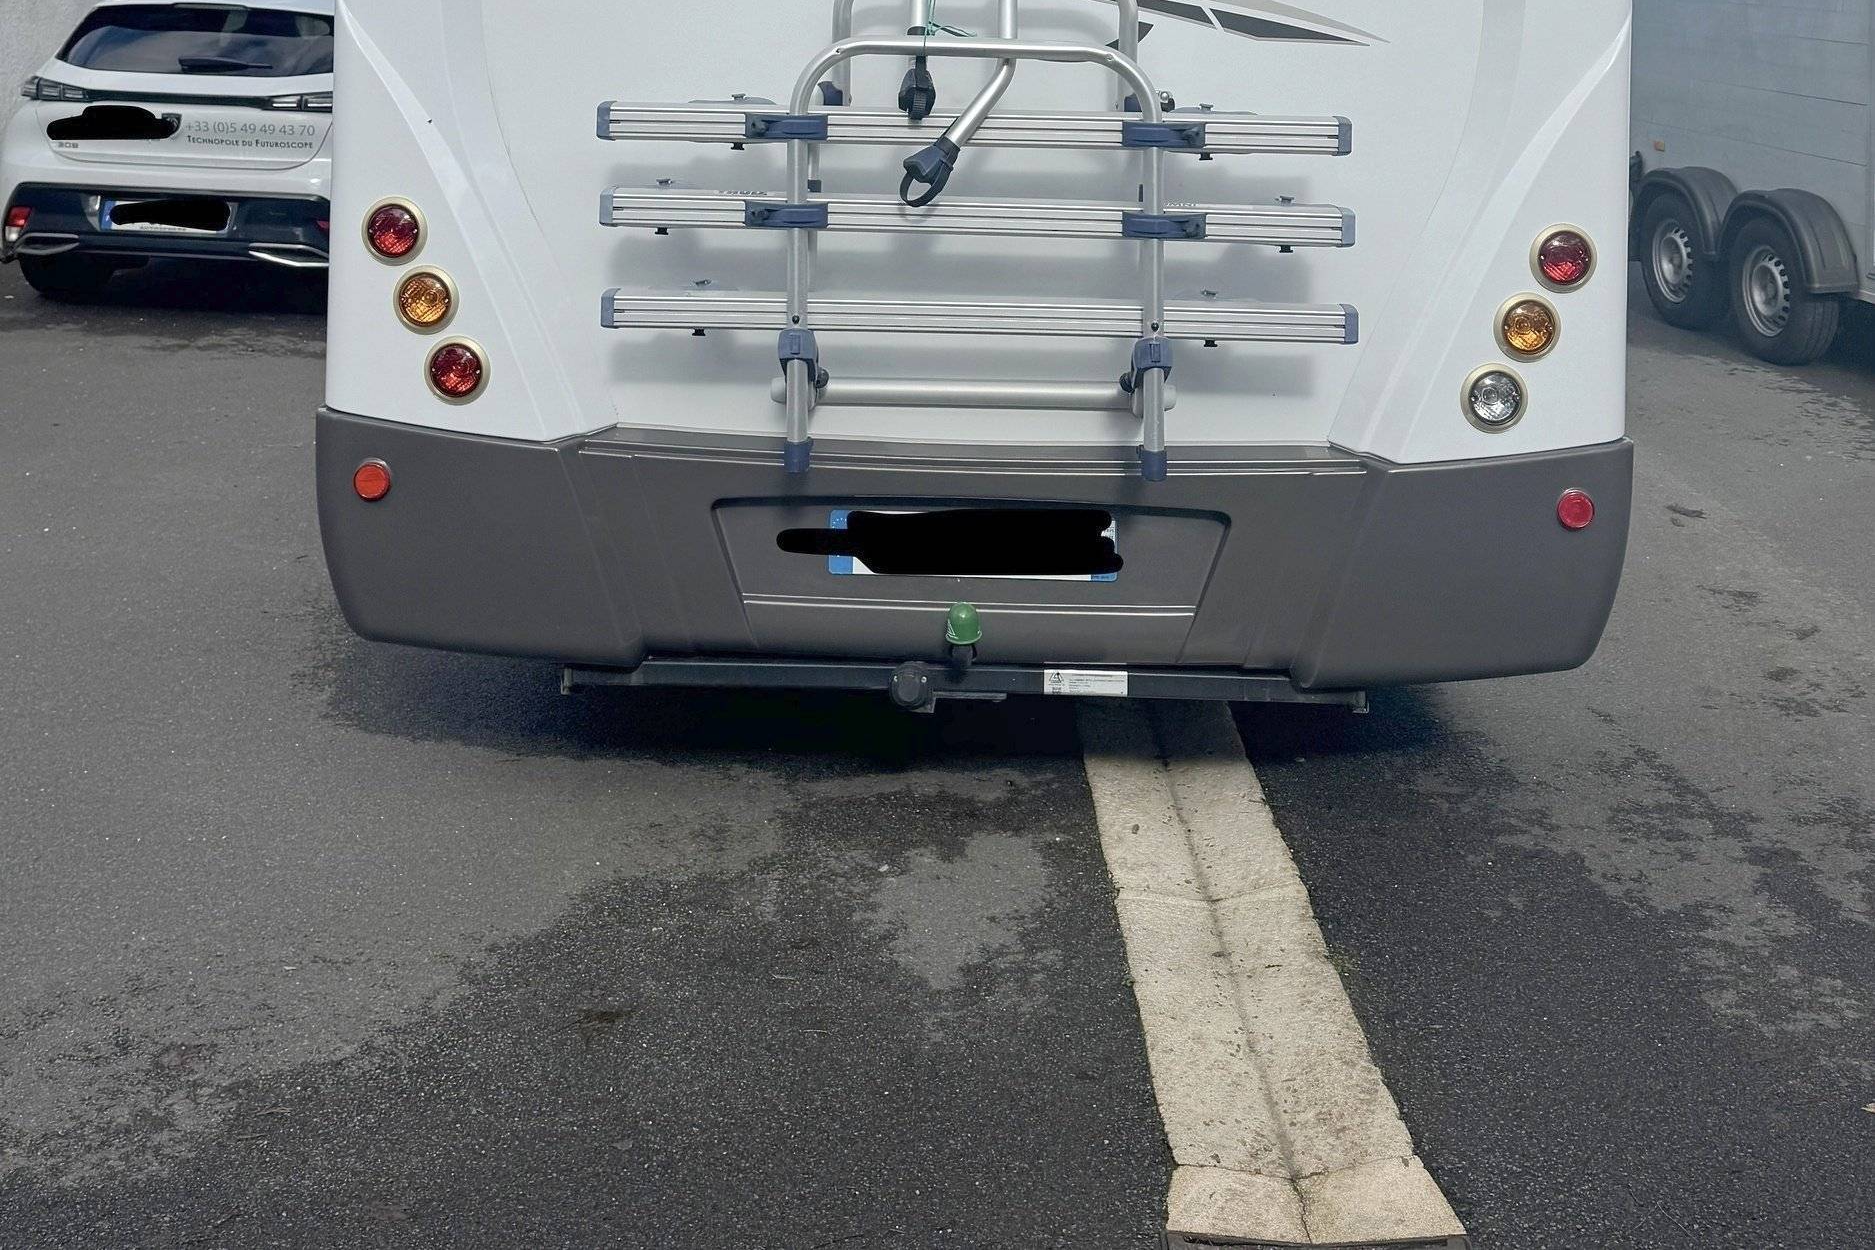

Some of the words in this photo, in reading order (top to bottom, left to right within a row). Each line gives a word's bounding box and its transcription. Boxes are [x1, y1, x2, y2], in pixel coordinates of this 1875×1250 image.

[186, 121, 209, 132] +33
[213, 121, 237, 134] (0)5
[241, 123, 257, 134] 49
[260, 124, 276, 135] 49
[279, 125, 295, 136] 43
[299, 125, 315, 136] 70
[187, 135, 239, 146] TECHNOPOLE
[255, 139, 313, 149] FUTUROSCOPE
